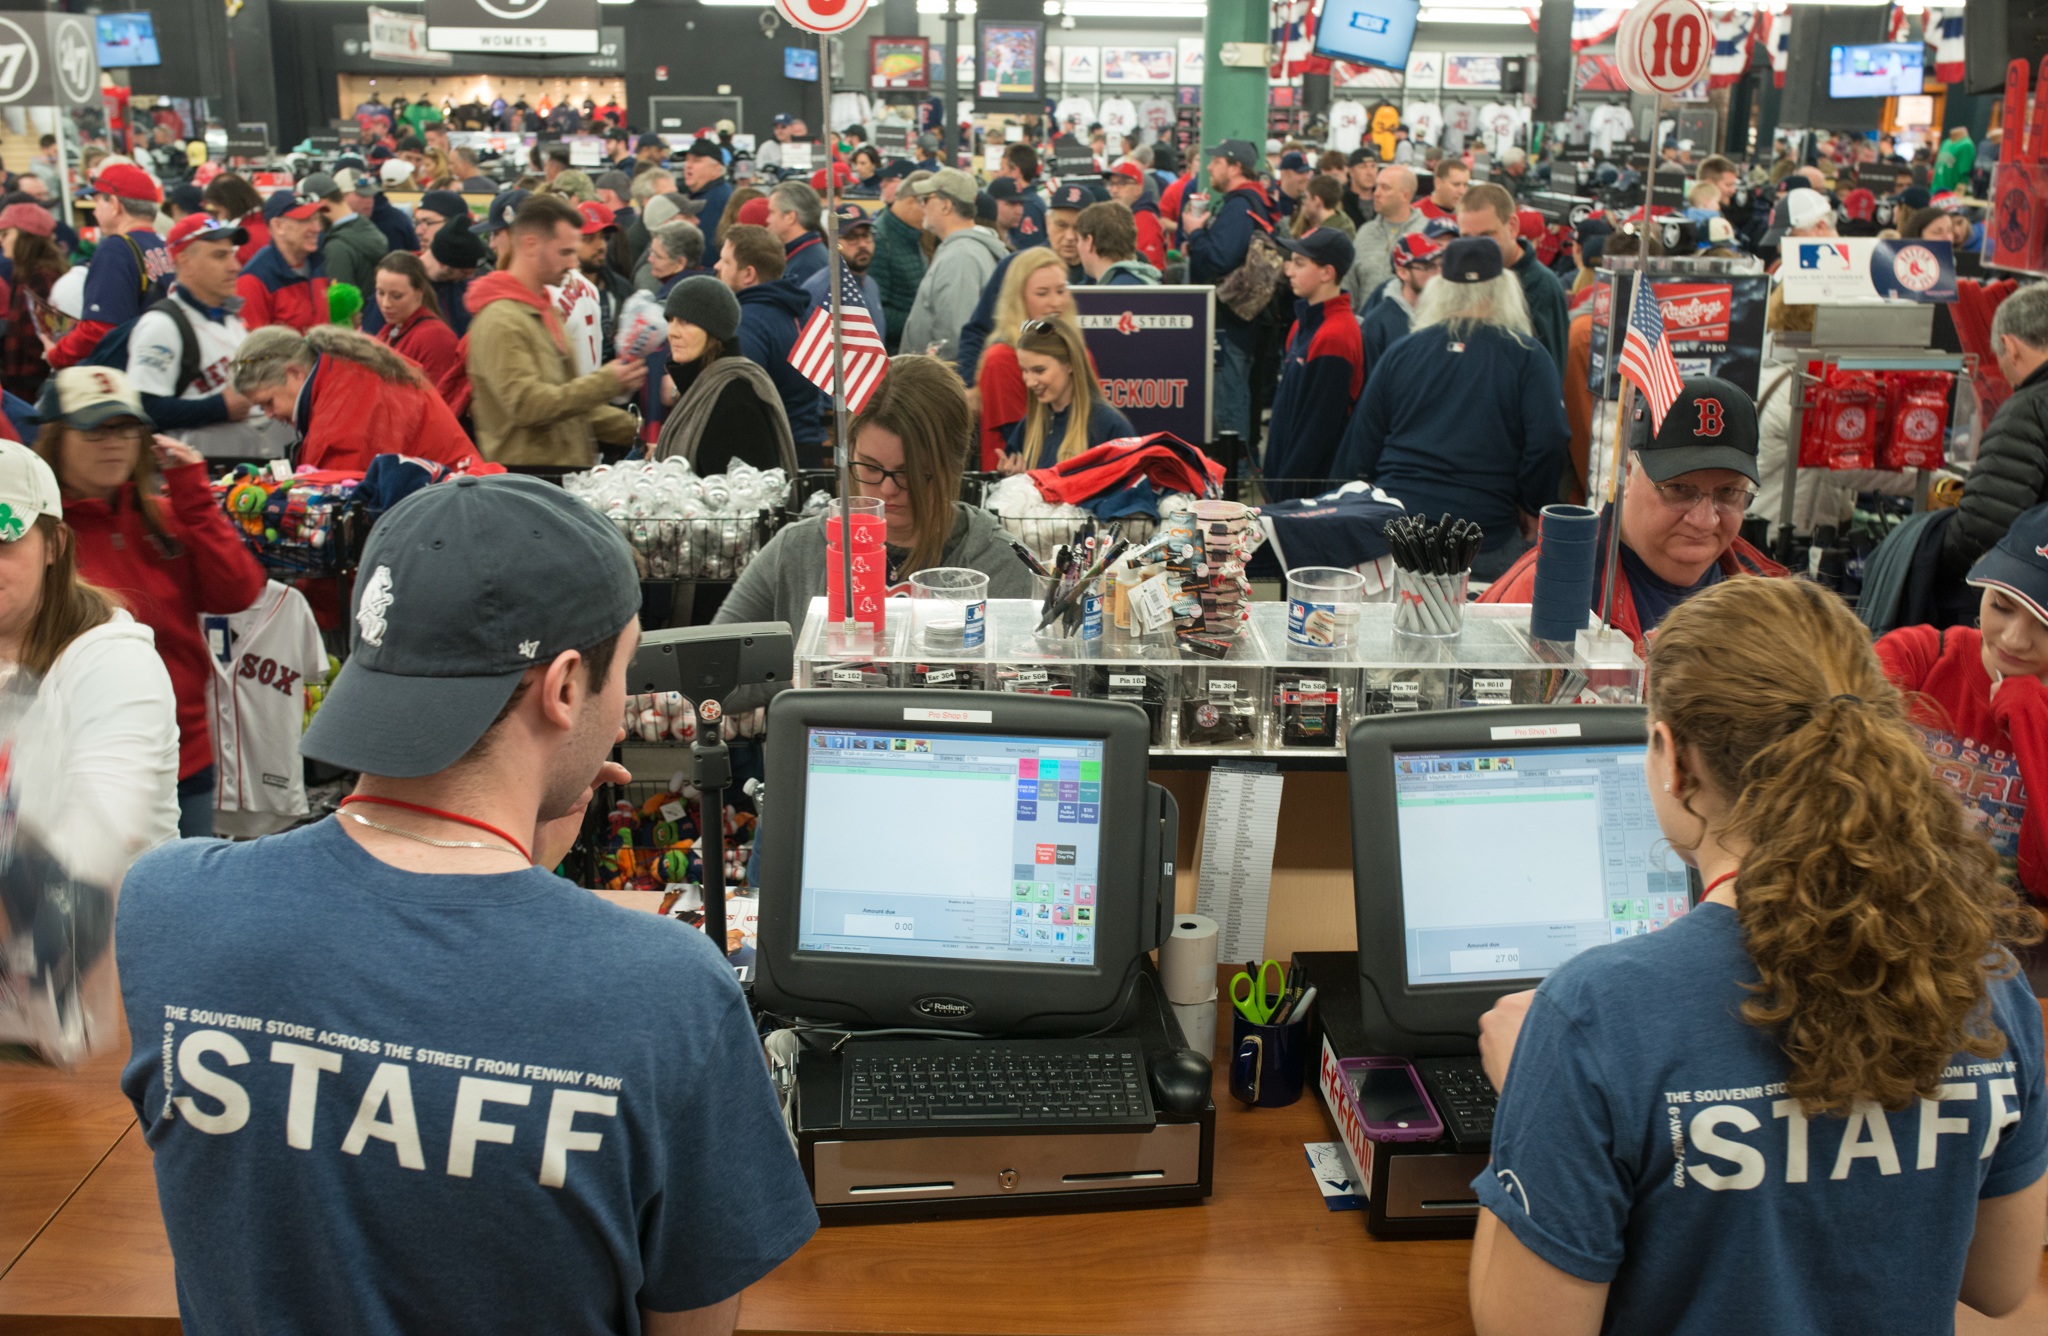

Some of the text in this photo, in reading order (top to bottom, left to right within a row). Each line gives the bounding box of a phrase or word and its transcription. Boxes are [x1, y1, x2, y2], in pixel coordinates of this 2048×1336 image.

[480, 35, 548, 47] WOMEN'S
[1650, 13, 1702, 77] 10
[1660, 297, 1725, 328] Rawlings
[1080, 317, 1186, 327] EAM STORE
[1098, 378, 1188, 408] ECKOUT
[1694, 397, 1725, 437] B
[239, 653, 301, 697] SOX
[927, 674, 940, 682] Ear
[1210, 682, 1222, 690] Pin
[1300, 682, 1312, 690] Pin
[928, 711, 968, 721] Pro Shop 9
[1514, 727, 1558, 737] Pro Shop 10
[862, 907, 884, 915] Amount
[894, 922, 913, 931] 0.00
[1495, 954, 1518, 963] 27.00
[934, 1003, 966, 1011] Radiant
[164, 1005, 623, 1091] THE SOUVENIR STORE ACROSS THE STREET FROM FENWAY PARK
[1664, 1091, 1692, 1104] THE
[1694, 1086, 1763, 1103] SOUVENIR
[172, 1029, 619, 1189] STAFF
